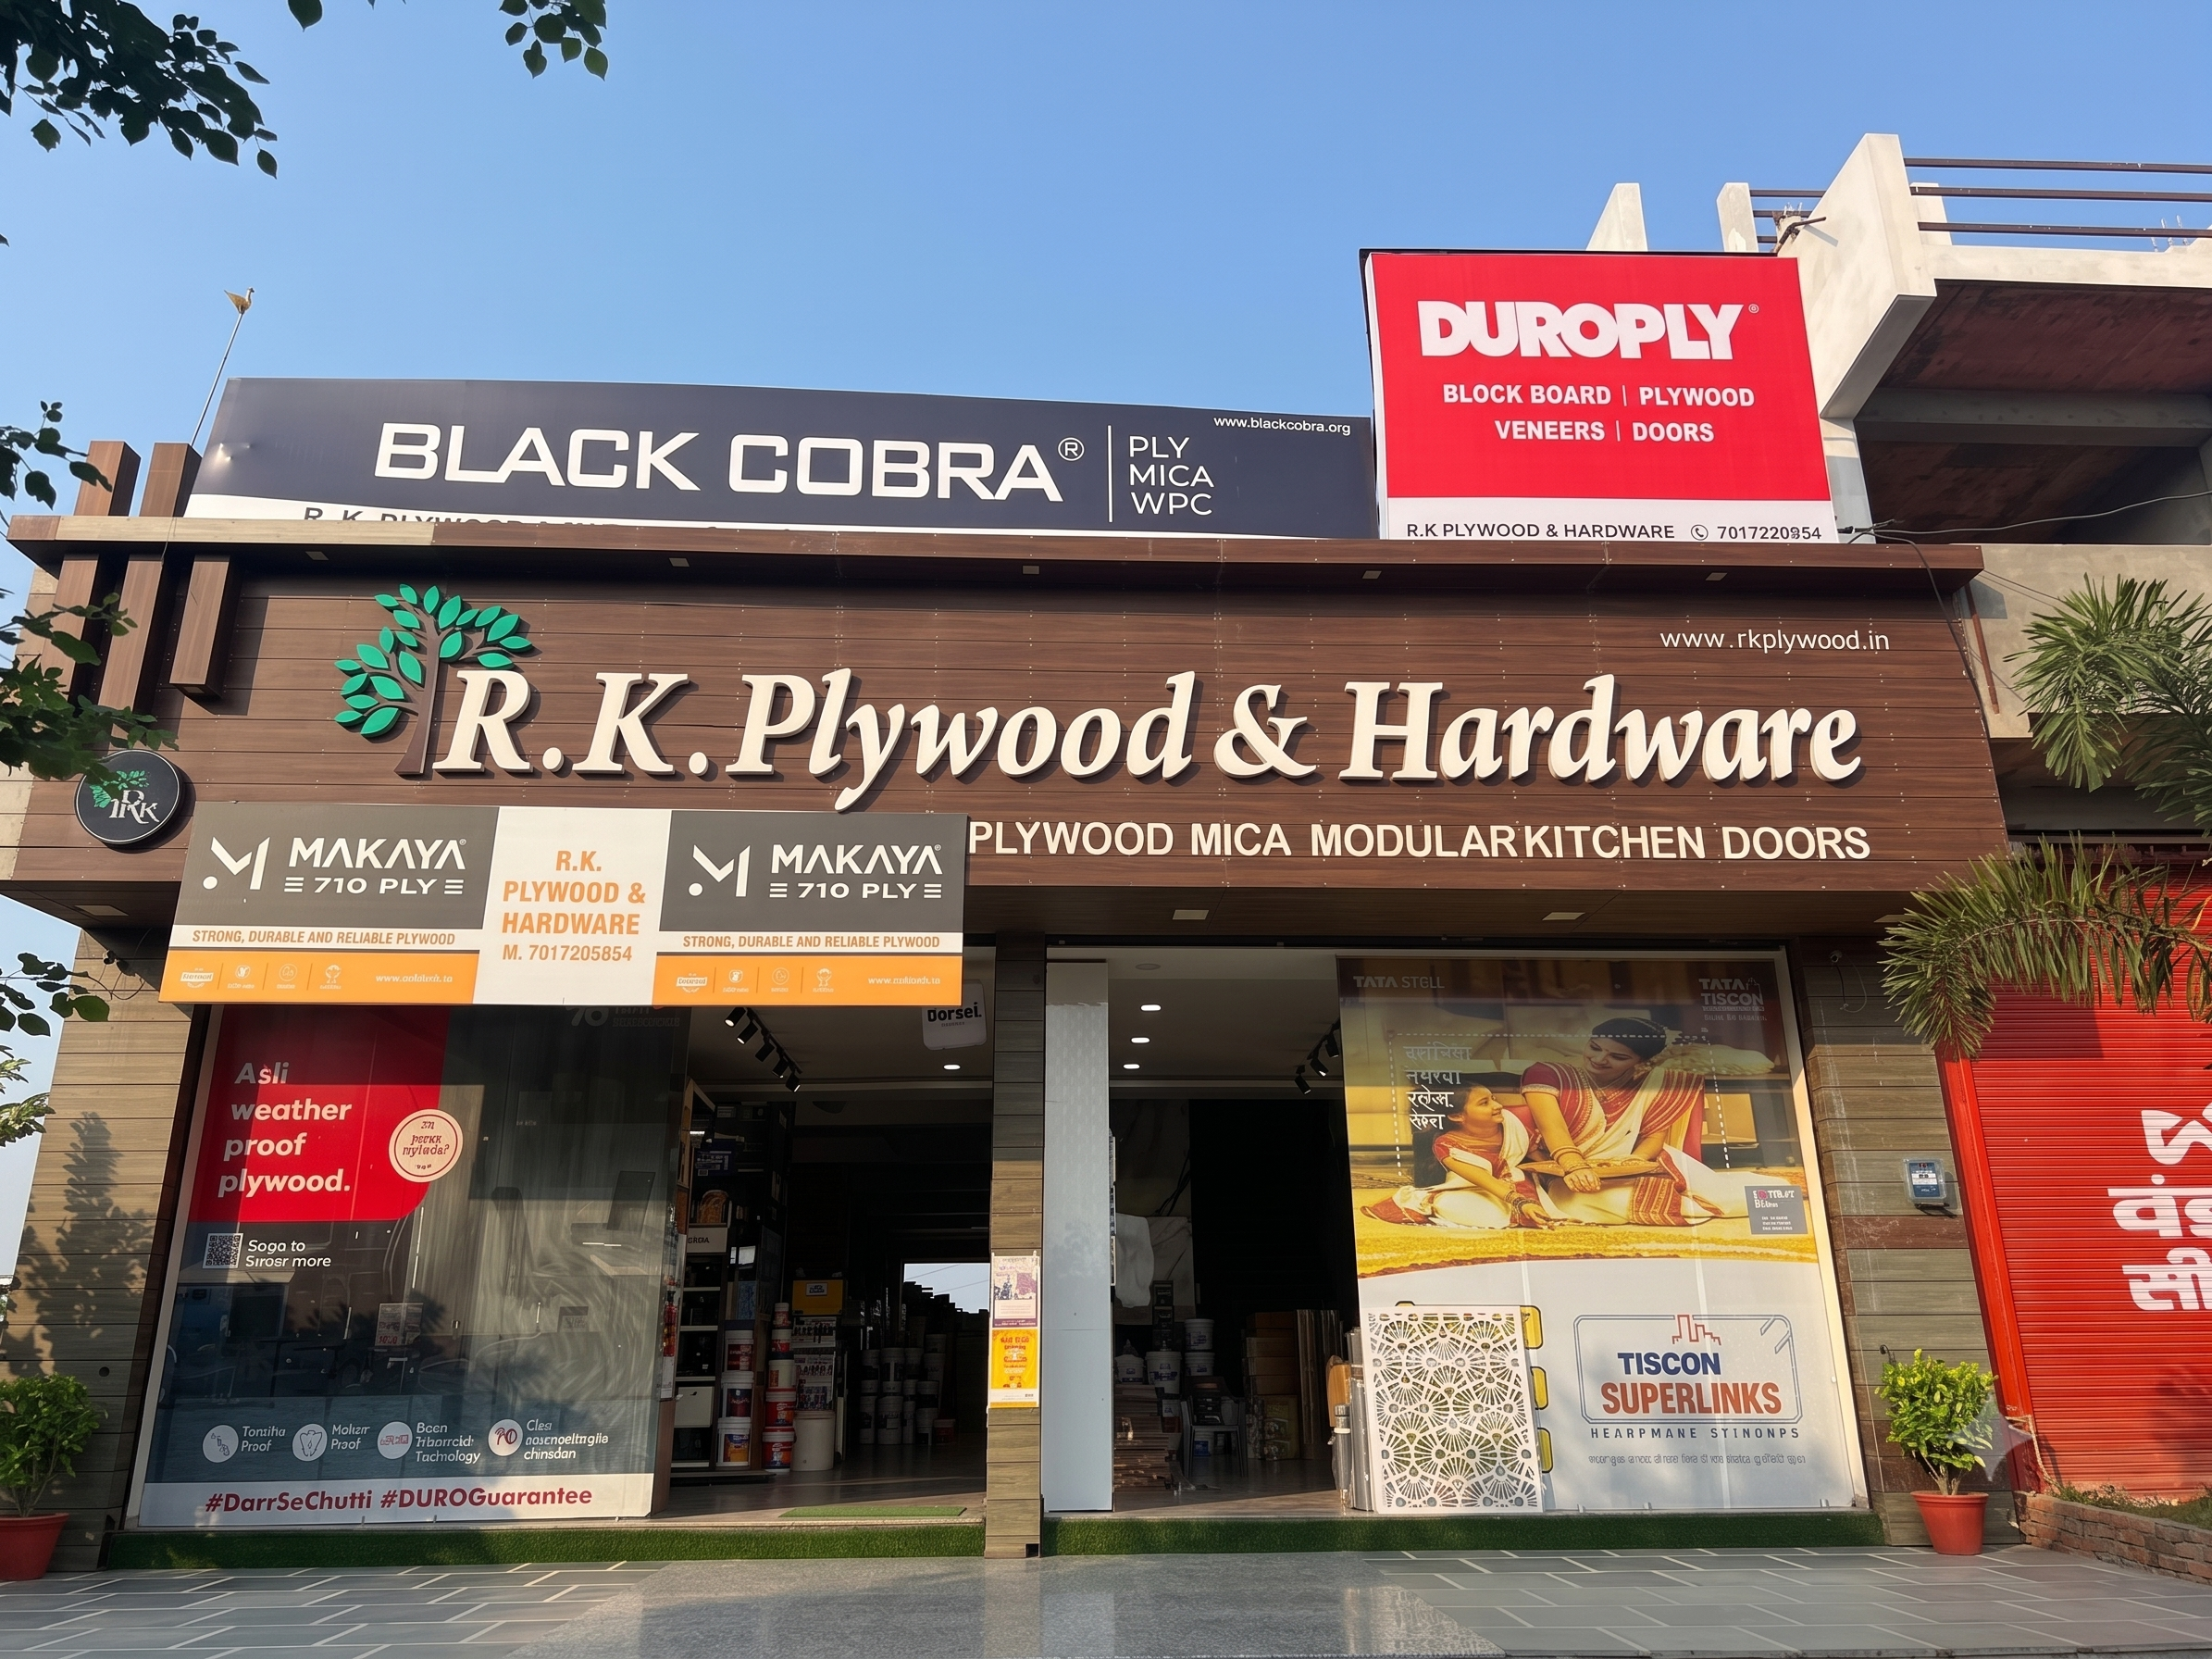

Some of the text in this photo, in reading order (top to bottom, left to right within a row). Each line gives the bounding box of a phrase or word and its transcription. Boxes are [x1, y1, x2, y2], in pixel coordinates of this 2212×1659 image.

[1418, 301, 1744, 360] DUROPLY
[1443, 384, 1755, 407] BLOCK BOARD PLYWOOD
[1214, 417, 1351, 436] www.blackcobra.org
[1495, 421, 1714, 443] VENEERS DOORS
[375, 423, 701, 492] BLACK
[1130, 436, 1190, 459] PLY
[1130, 464, 1214, 488] MICA
[1131, 492, 1212, 516] WPC
[1443, 524, 1540, 538] PLYWOOD
[1546, 524, 1559, 538] &
[1564, 525, 1675, 539] HARDWARE
[1660, 630, 1890, 655] www.rkplywood.in
[1213, 684, 1318, 780] &
[1338, 674, 1863, 783] Hardware
[970, 822, 1174, 856] PLYWOOD
[1192, 823, 1292, 856] MICA
[1722, 827, 1870, 860] DOORS
[555, 851, 602, 872] R.K.
[315, 877, 438, 895] 710 PLY
[503, 881, 646, 904] PLYWOOD &
[798, 882, 917, 899] 710 PLY
[502, 912, 640, 935] HARDWARE
[193, 930, 455, 945] STRONG, DURABLE AND RELIABLE PLYWOOD
[682, 935, 940, 949] STRONG, DURABLE AND RELIABLE PLYWOOD
[503, 944, 632, 962] M. 7017205854
[1352, 976, 1398, 988] TATA
[1698, 979, 1746, 991] TATA
[1701, 993, 1764, 1005] TISCON
[234, 1062, 290, 1084] Asli
[231, 1097, 353, 1121] weather
[223, 1131, 308, 1162] proof
[217, 1167, 352, 1198] plywood.
[291, 1241, 306, 1253] to
[292, 1256, 331, 1267] more
[1617, 1352, 1721, 1376] TISCON
[1600, 1382, 1782, 1415] SUPERLINKS
[205, 1487, 593, 1513] #DarrSeChutti #DUROGuarantee
